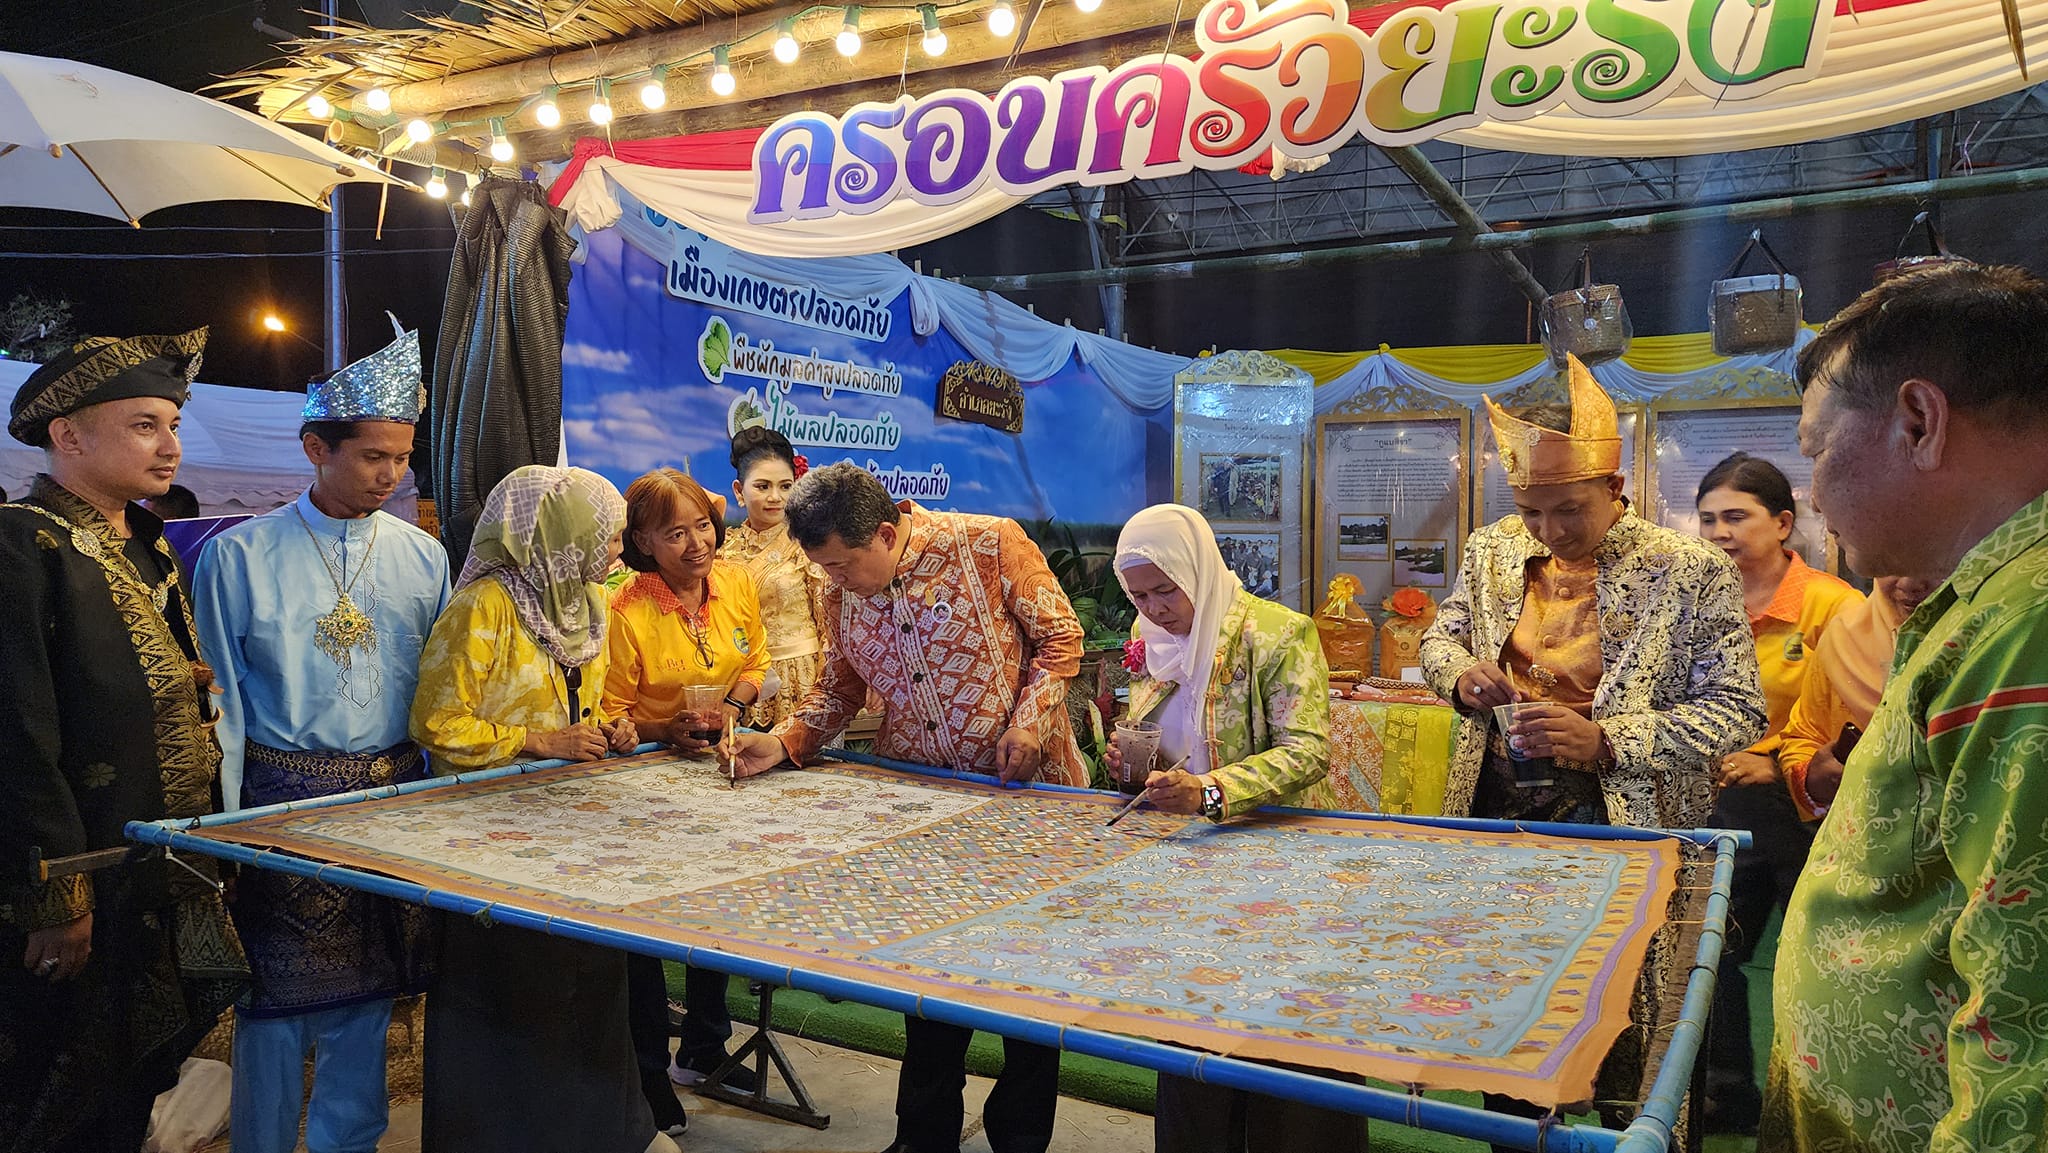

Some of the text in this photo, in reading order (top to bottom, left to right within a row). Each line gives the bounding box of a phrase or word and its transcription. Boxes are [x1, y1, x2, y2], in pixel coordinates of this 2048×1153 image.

[754, 0, 1822, 215] ครอบครัวยะรง
[670, 244, 890, 338] เมืองเกษตรปลอดภัย
